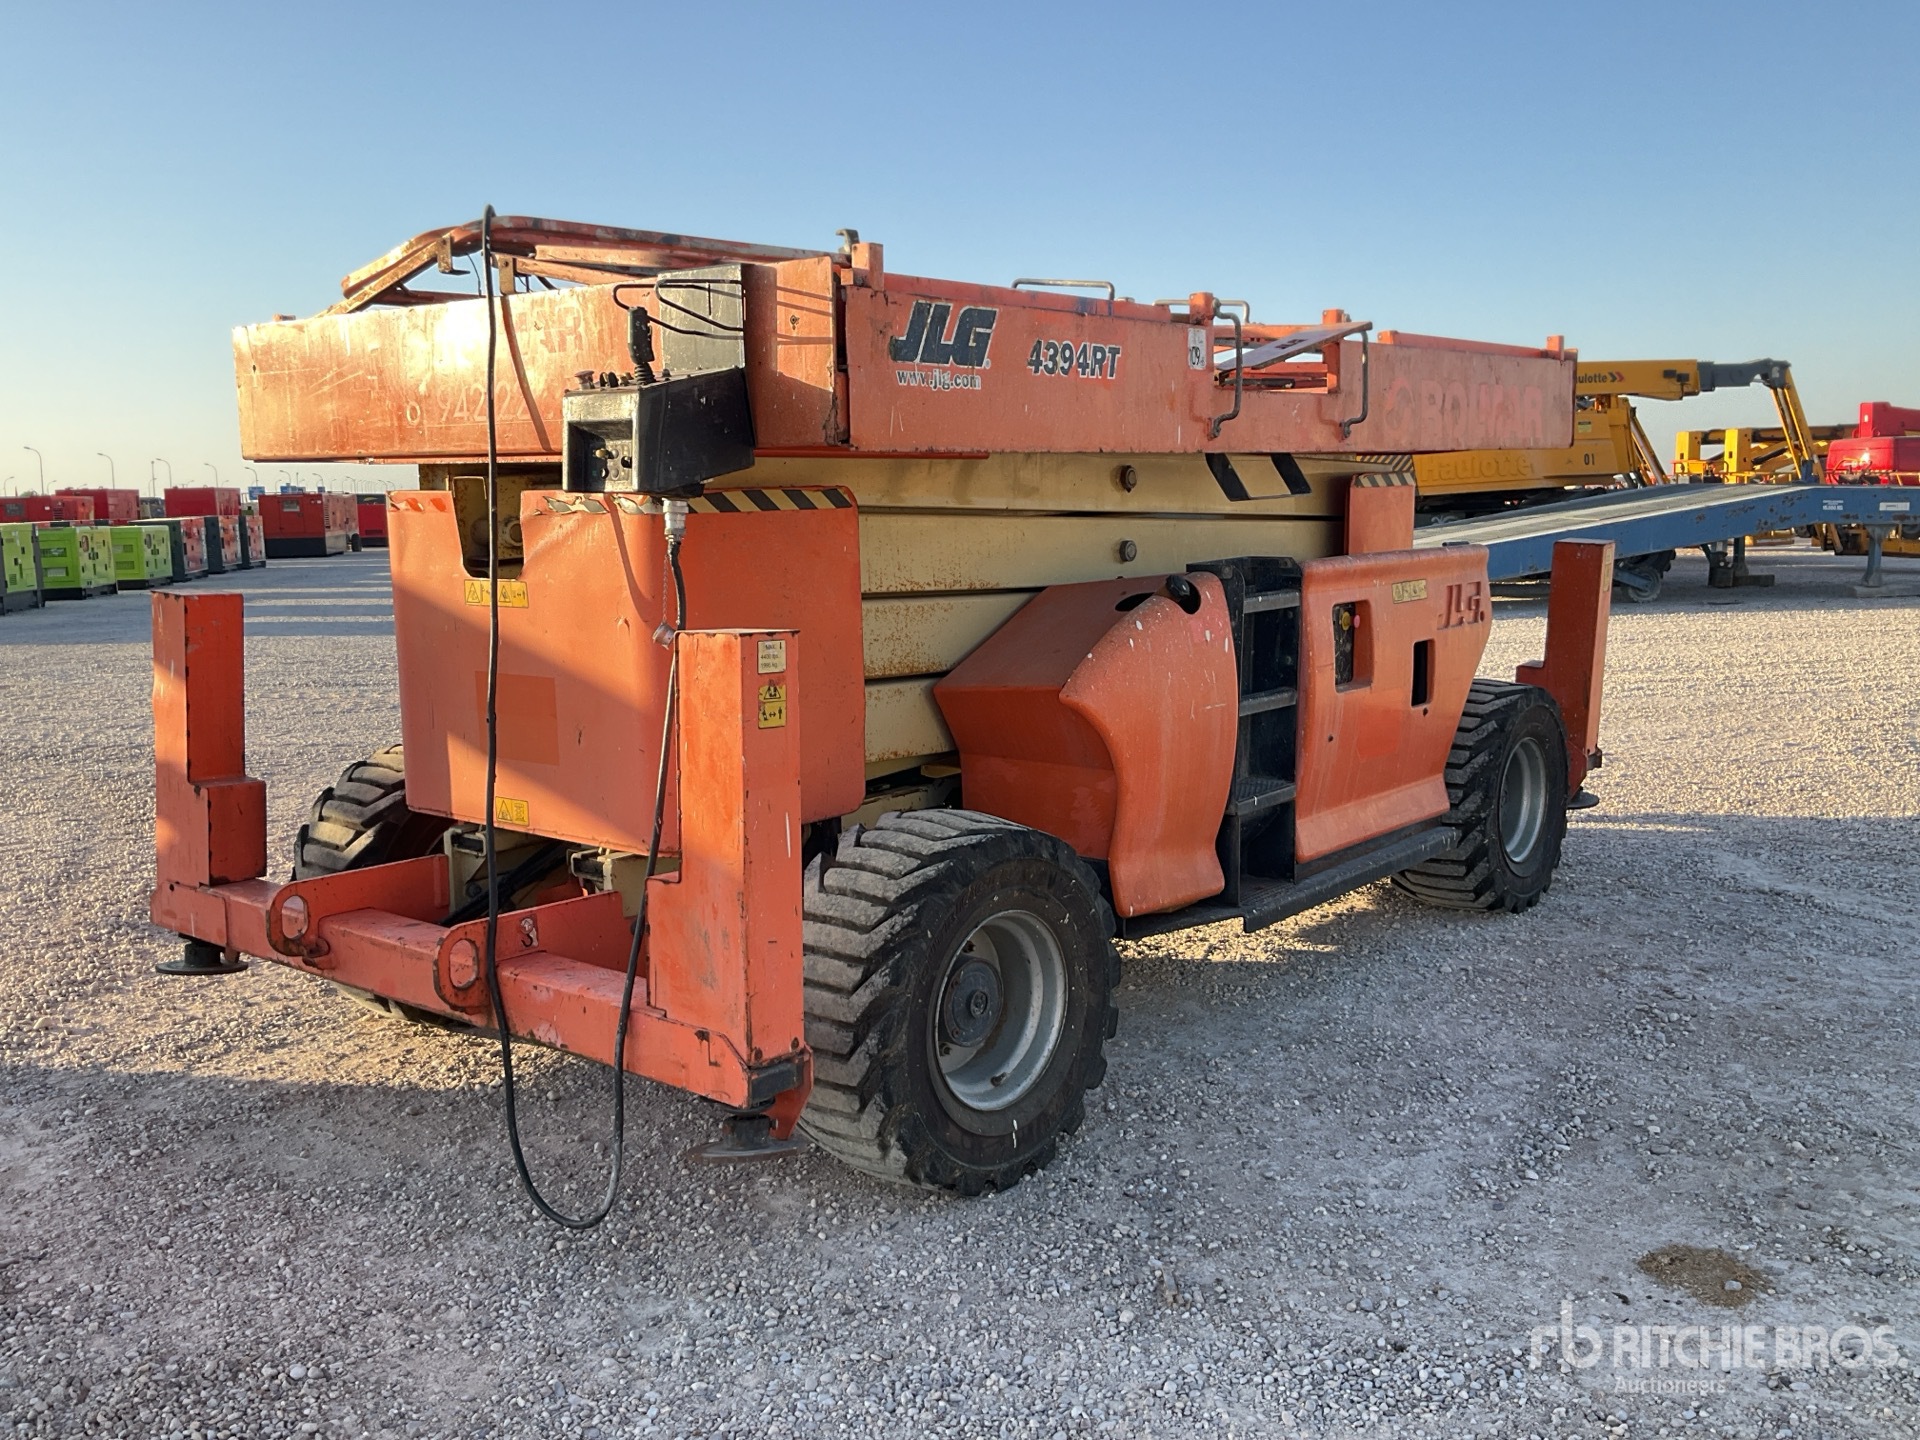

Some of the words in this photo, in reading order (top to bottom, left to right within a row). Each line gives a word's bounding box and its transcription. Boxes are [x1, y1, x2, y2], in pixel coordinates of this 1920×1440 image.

[1027, 339, 1121, 380] 4394RT
[896, 369, 981, 391] www.jlg.com
[1575, 372, 1607, 383] ulotte
